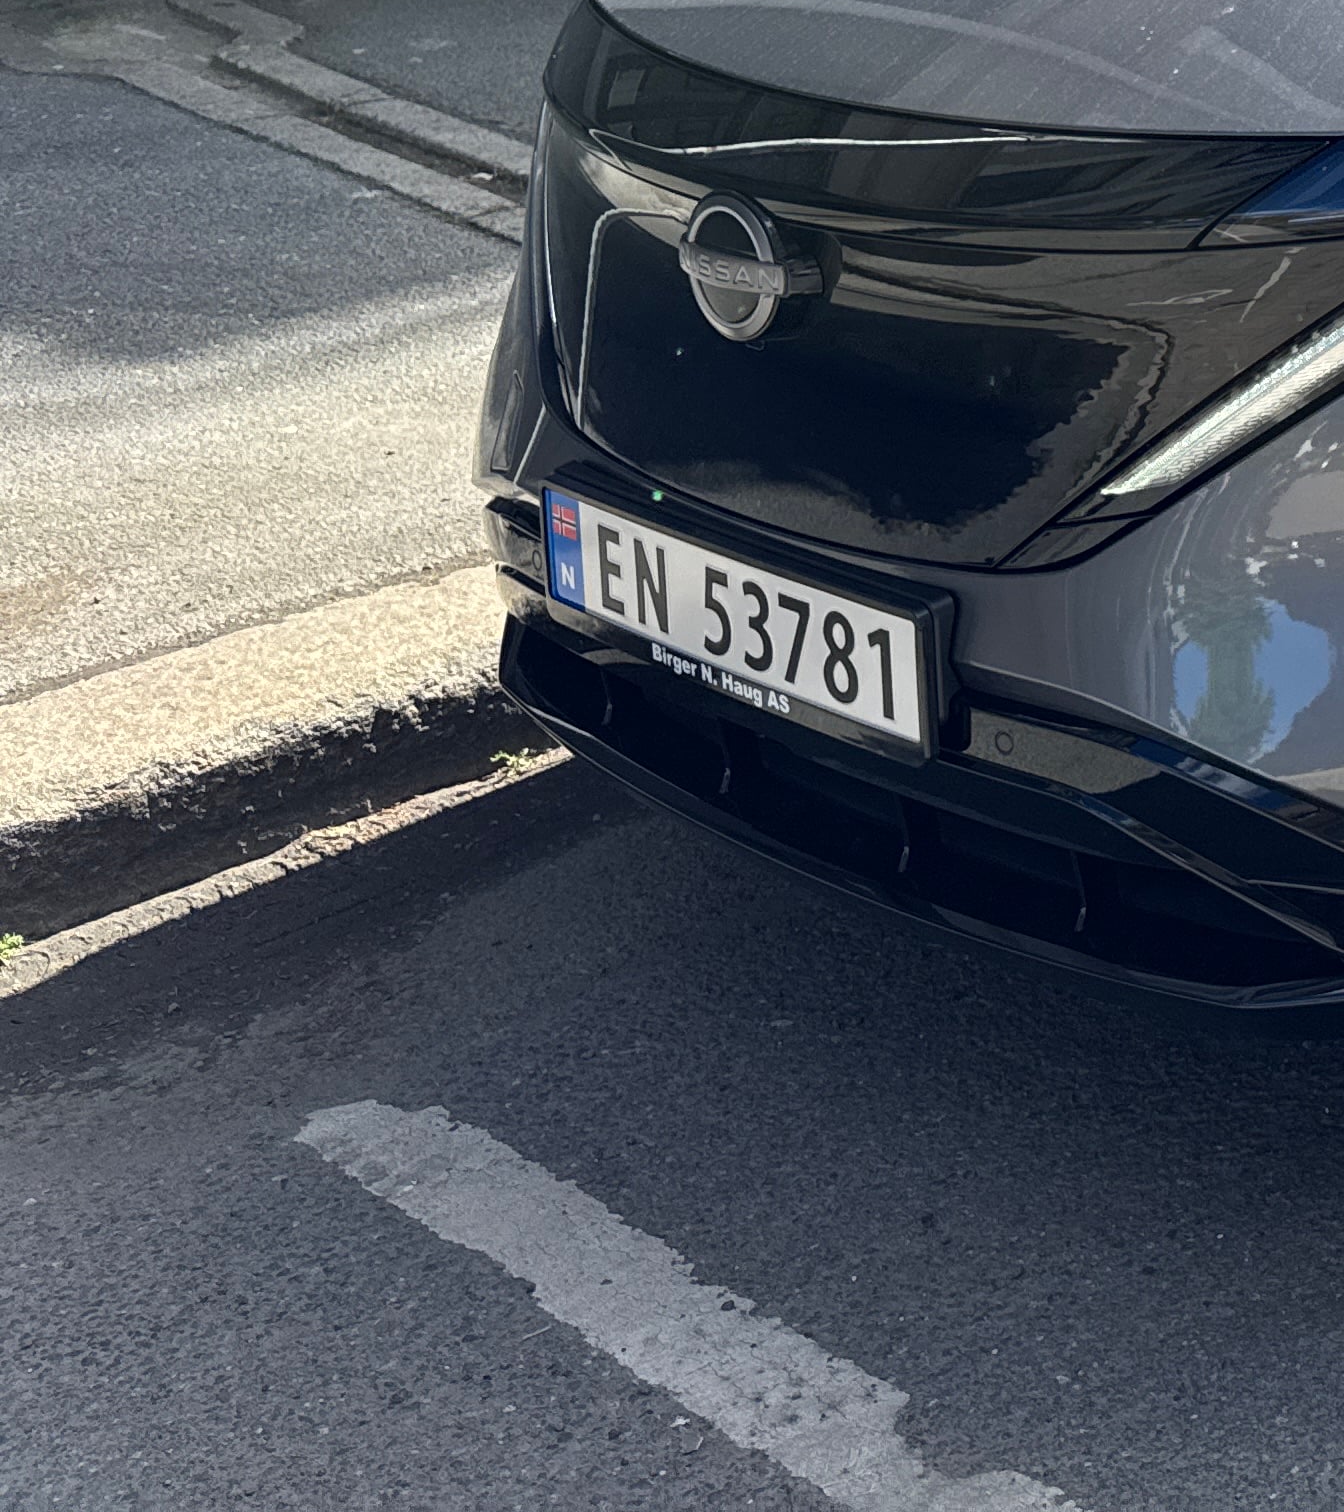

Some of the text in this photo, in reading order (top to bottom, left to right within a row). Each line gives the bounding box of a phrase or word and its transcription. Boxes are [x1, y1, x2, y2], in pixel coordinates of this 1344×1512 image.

[560, 562, 576, 590] N
[597, 523, 895, 721] EN 53781
[652, 642, 790, 714] Birger N. Haug AS
